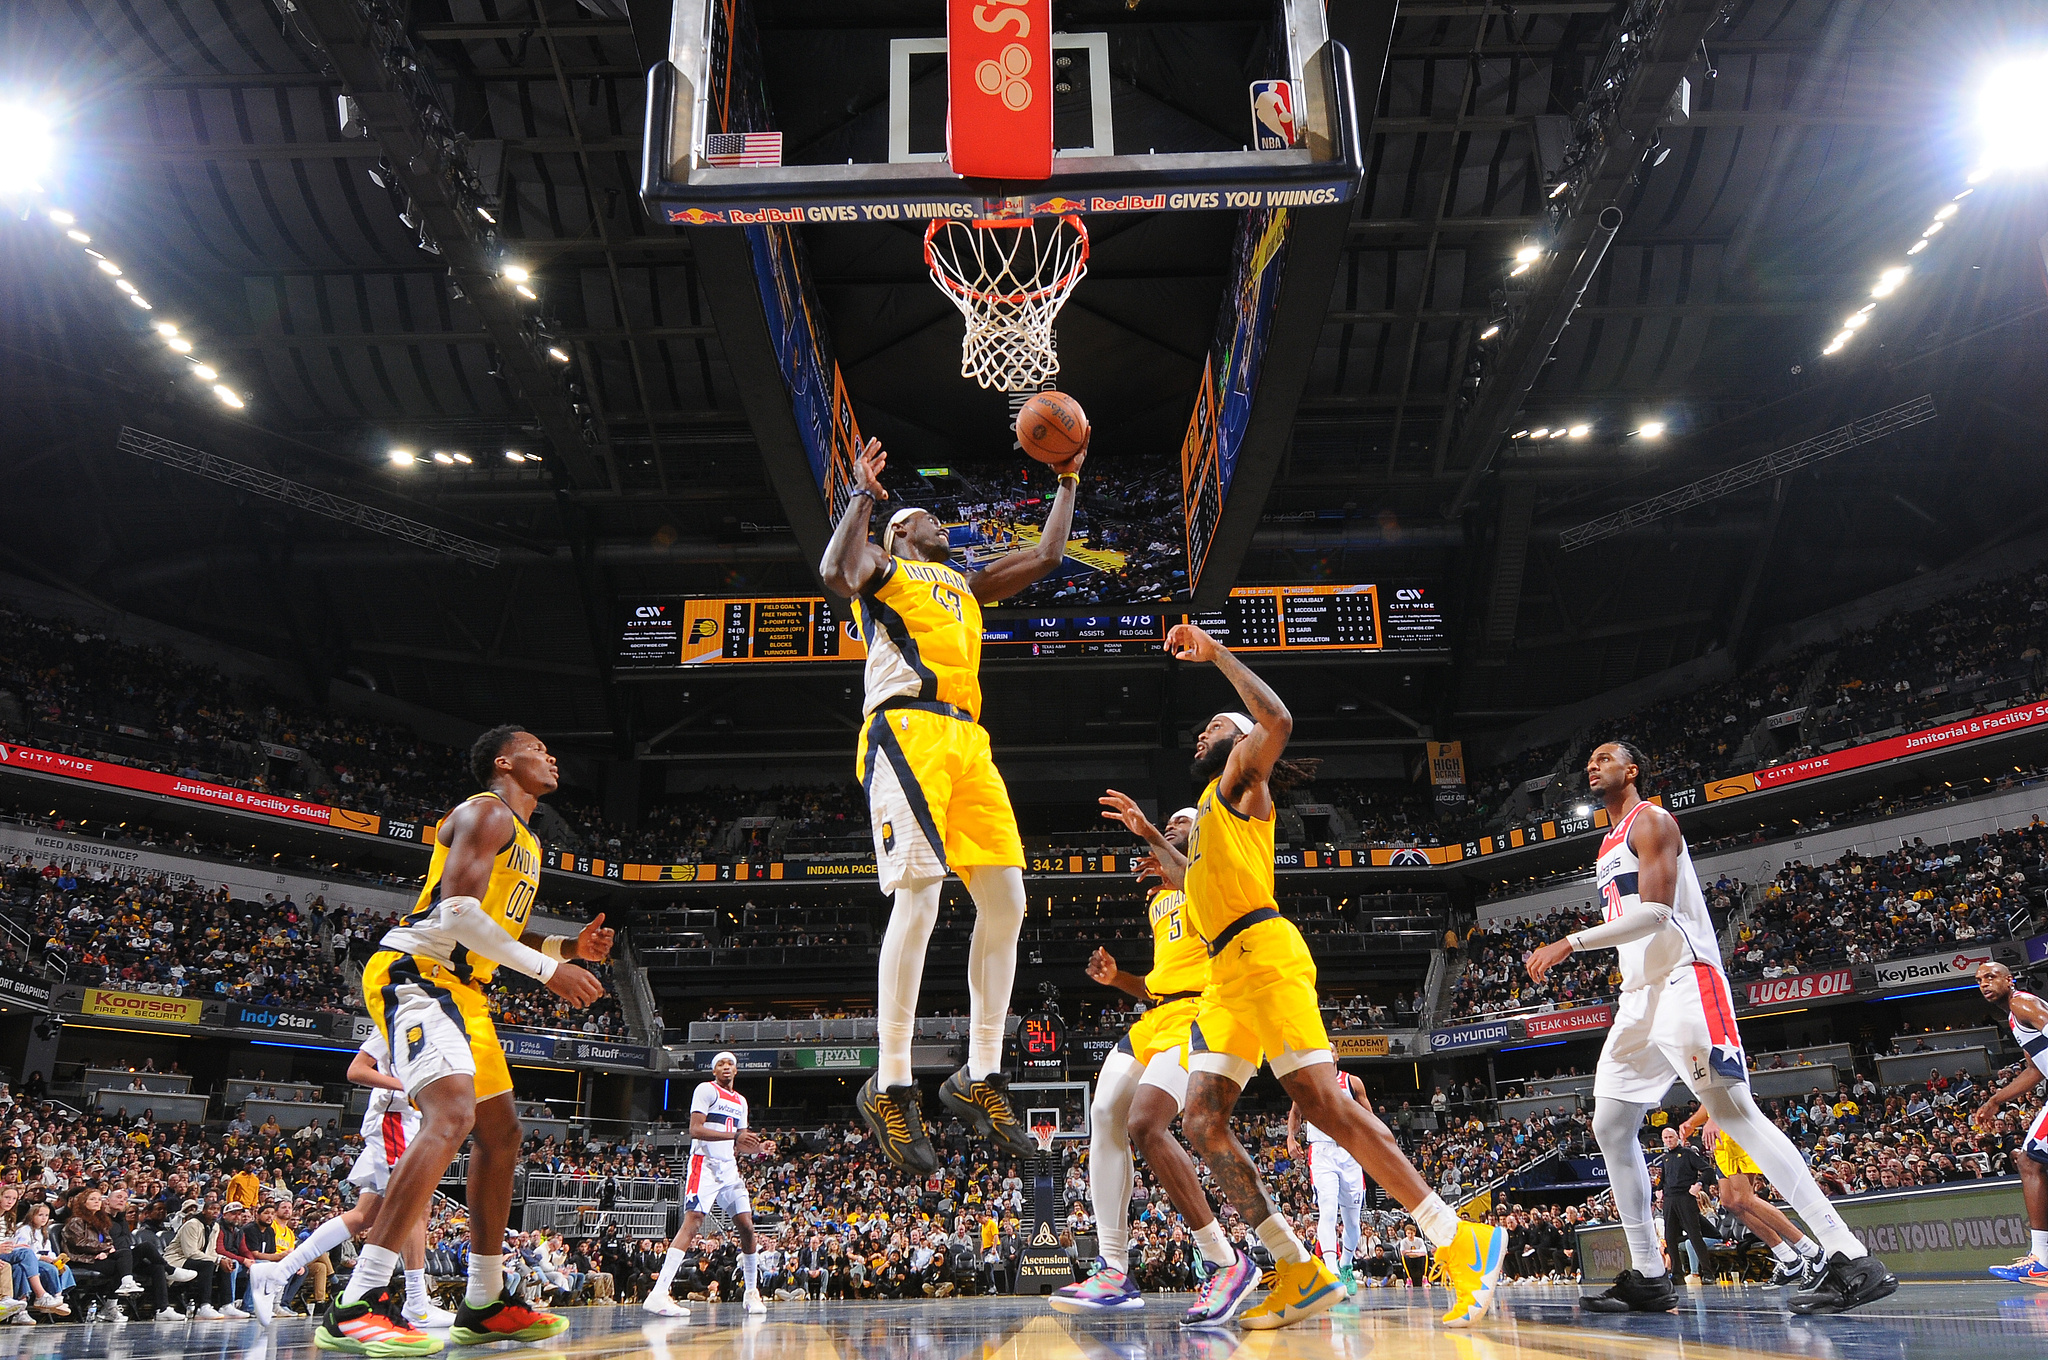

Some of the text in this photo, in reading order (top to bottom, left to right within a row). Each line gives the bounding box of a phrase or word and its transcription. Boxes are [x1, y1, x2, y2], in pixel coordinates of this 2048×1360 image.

[1261, 136, 1282, 149] NBA
[1090, 197, 1127, 211] Red
[1127, 194, 1166, 210] Bull
[1169, 193, 1219, 209] GIVES
[1224, 191, 1261, 207] YOU
[728, 208, 769, 224] Red
[768, 207, 806, 222] Bull
[807, 205, 857, 221] GIVES
[862, 203, 900, 220] YOU
[932, 584, 964, 624] 43
[1035, 630, 1060, 638] POINTS
[1769, 717, 1783, 727] 204
[1905, 711, 2033, 748] Janitorial & Facility
[19, 751, 53, 763] CITY
[58, 758, 94, 772] WIDE
[1433, 758, 1460, 770] HIGH
[1768, 758, 1830, 779] CITY WIDE
[173, 781, 291, 814] Janitorial & Facility
[1671, 794, 1697, 809] 5/17
[388, 826, 414, 839] 7/20
[1560, 820, 1590, 834] 19/43
[1530, 832, 1537, 842] 4
[35, 836, 139, 862] NEED ASSISTANCE?
[1498, 840, 1505, 849] 9
[1465, 846, 1478, 857] 24
[547, 857, 555, 866] 4
[577, 862, 589, 872] 15
[1033, 858, 1064, 871] 34.2
[1089, 862, 1096, 871] 2
[1325, 857, 1332, 866] 4
[1358, 856, 1366, 865] 4
[607, 868, 619, 878] 24
[721, 870, 729, 879] 4
[756, 870, 763, 878] 4
[807, 864, 878, 876] INDIANA PACE
[505, 879, 536, 924] 00
[1169, 909, 1183, 942] 5
[1877, 961, 1951, 983] KeyBank
[14, 982, 50, 1000] GRAPHICS
[1748, 972, 1852, 1004] LUCAS OIL
[95, 992, 188, 1014] Koorsen
[93, 1005, 117, 1014] FIRE
[134, 1010, 186, 1021] SECURITY
[240, 1009, 318, 1029] IndyStar.
[1026, 1020, 1050, 1032] 34.1
[1528, 1012, 1607, 1033] STEAK N SHAKE
[1453, 1026, 1508, 1043] HYUNDAI
[520, 1041, 536, 1049] CPAs
[1028, 1031, 1056, 1053] 24
[1083, 1041, 1114, 1049] WIZARDS
[1342, 1038, 1385, 1047] ACADEMY
[519, 1047, 545, 1056] Advisors
[591, 1046, 620, 1060] Ruoff
[825, 1049, 861, 1060] RYAN
[1093, 1051, 1104, 1061] 52
[1900, 1216, 2027, 1250] YOUR PUNCH
[1022, 1255, 1069, 1265] Ascension
[1592, 1248, 1626, 1272] PUNCH
[1021, 1266, 1072, 1276] St. Vincent
